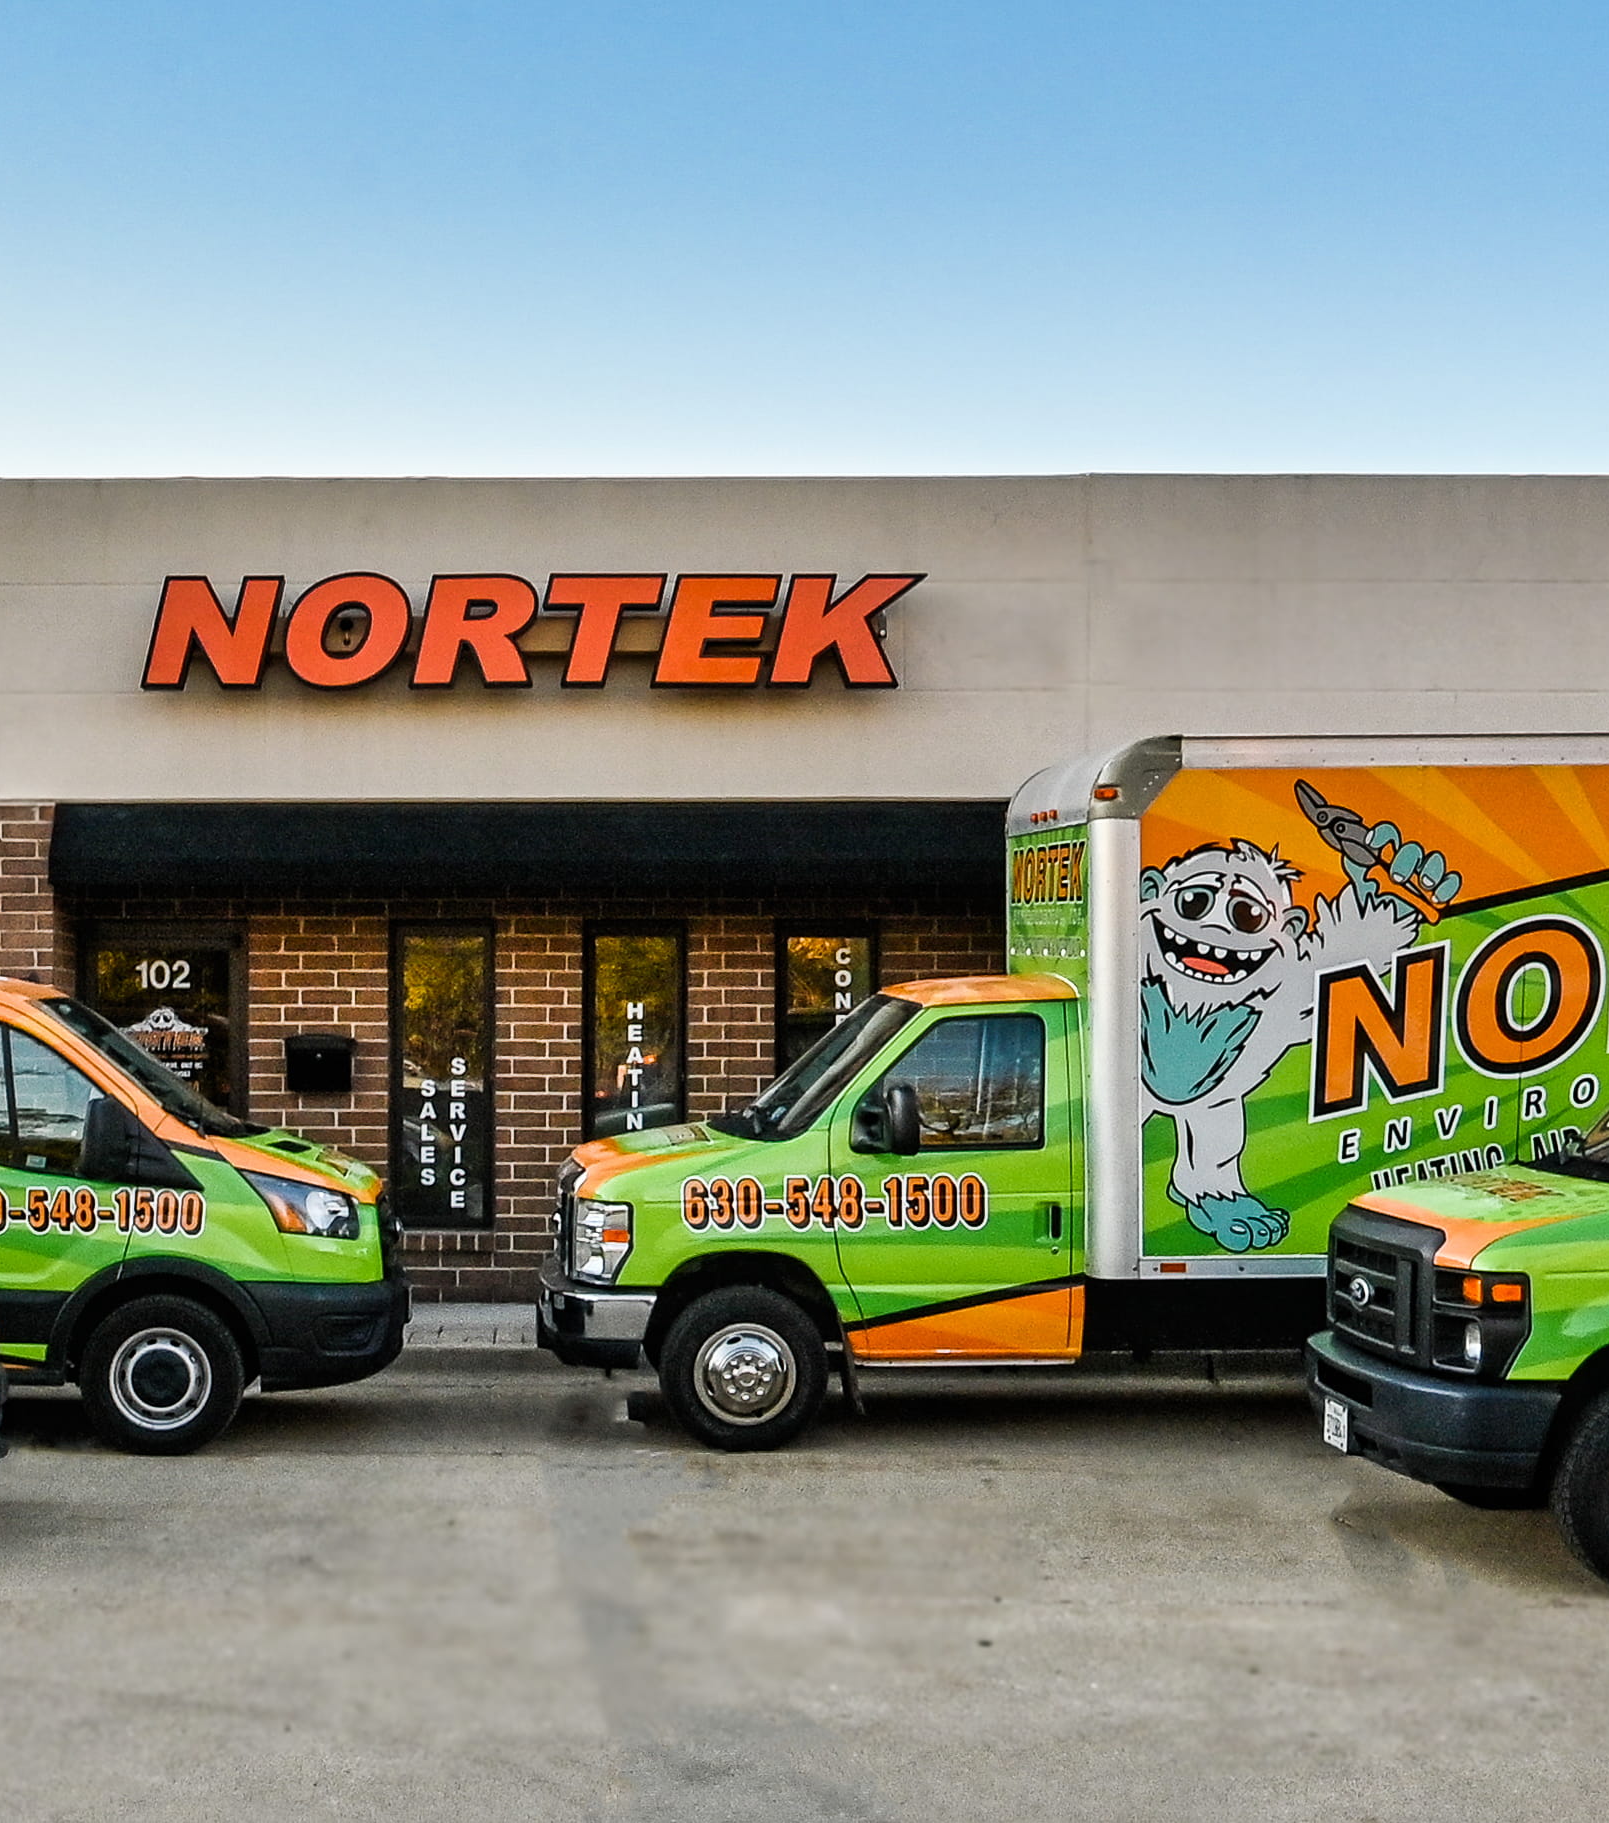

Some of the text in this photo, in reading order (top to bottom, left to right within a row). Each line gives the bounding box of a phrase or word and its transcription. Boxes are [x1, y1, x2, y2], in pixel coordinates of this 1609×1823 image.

[141, 571, 928, 690] NORTEK
[1011, 838, 1087, 905] NORTEK
[135, 960, 191, 989] 102
[420, 1080, 437, 1186] SALES
[449, 1057, 467, 1208] SERVICE
[680, 1172, 988, 1233] 630-548-1500
